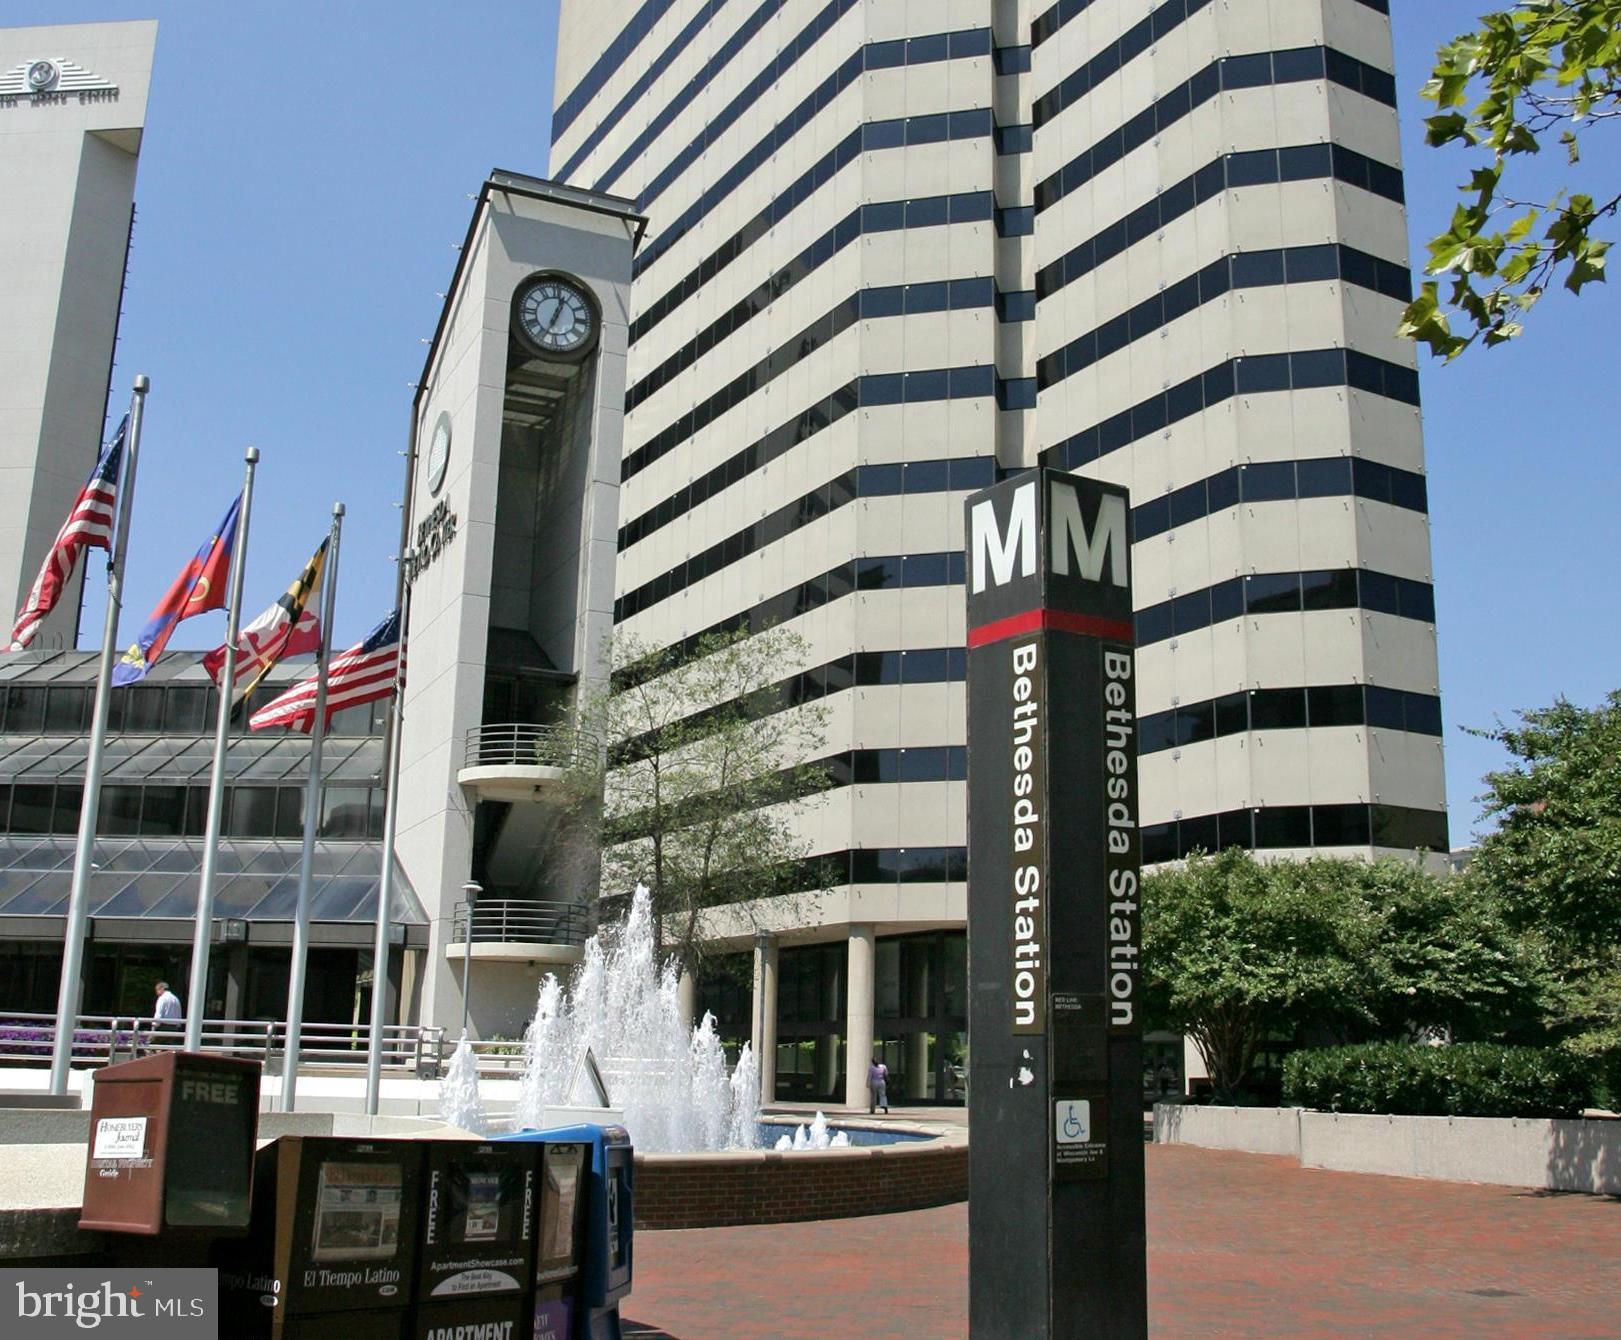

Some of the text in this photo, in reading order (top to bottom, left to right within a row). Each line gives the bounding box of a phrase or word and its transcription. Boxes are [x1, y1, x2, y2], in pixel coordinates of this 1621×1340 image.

[971, 481, 1036, 595] M
[1051, 480, 1128, 588] M
[1012, 643, 1041, 1025] Bethesda Station
[1104, 651, 1138, 1025] Bethesda Station
[181, 1080, 240, 1105] FREE
[427, 1170, 440, 1245] FREE
[522, 1170, 533, 1240] FREE
[246, 1272, 281, 1294] Latino
[303, 1267, 400, 1289] El Tiempo Latino
[430, 1257, 525, 1272] ApartmentShowcase.com
